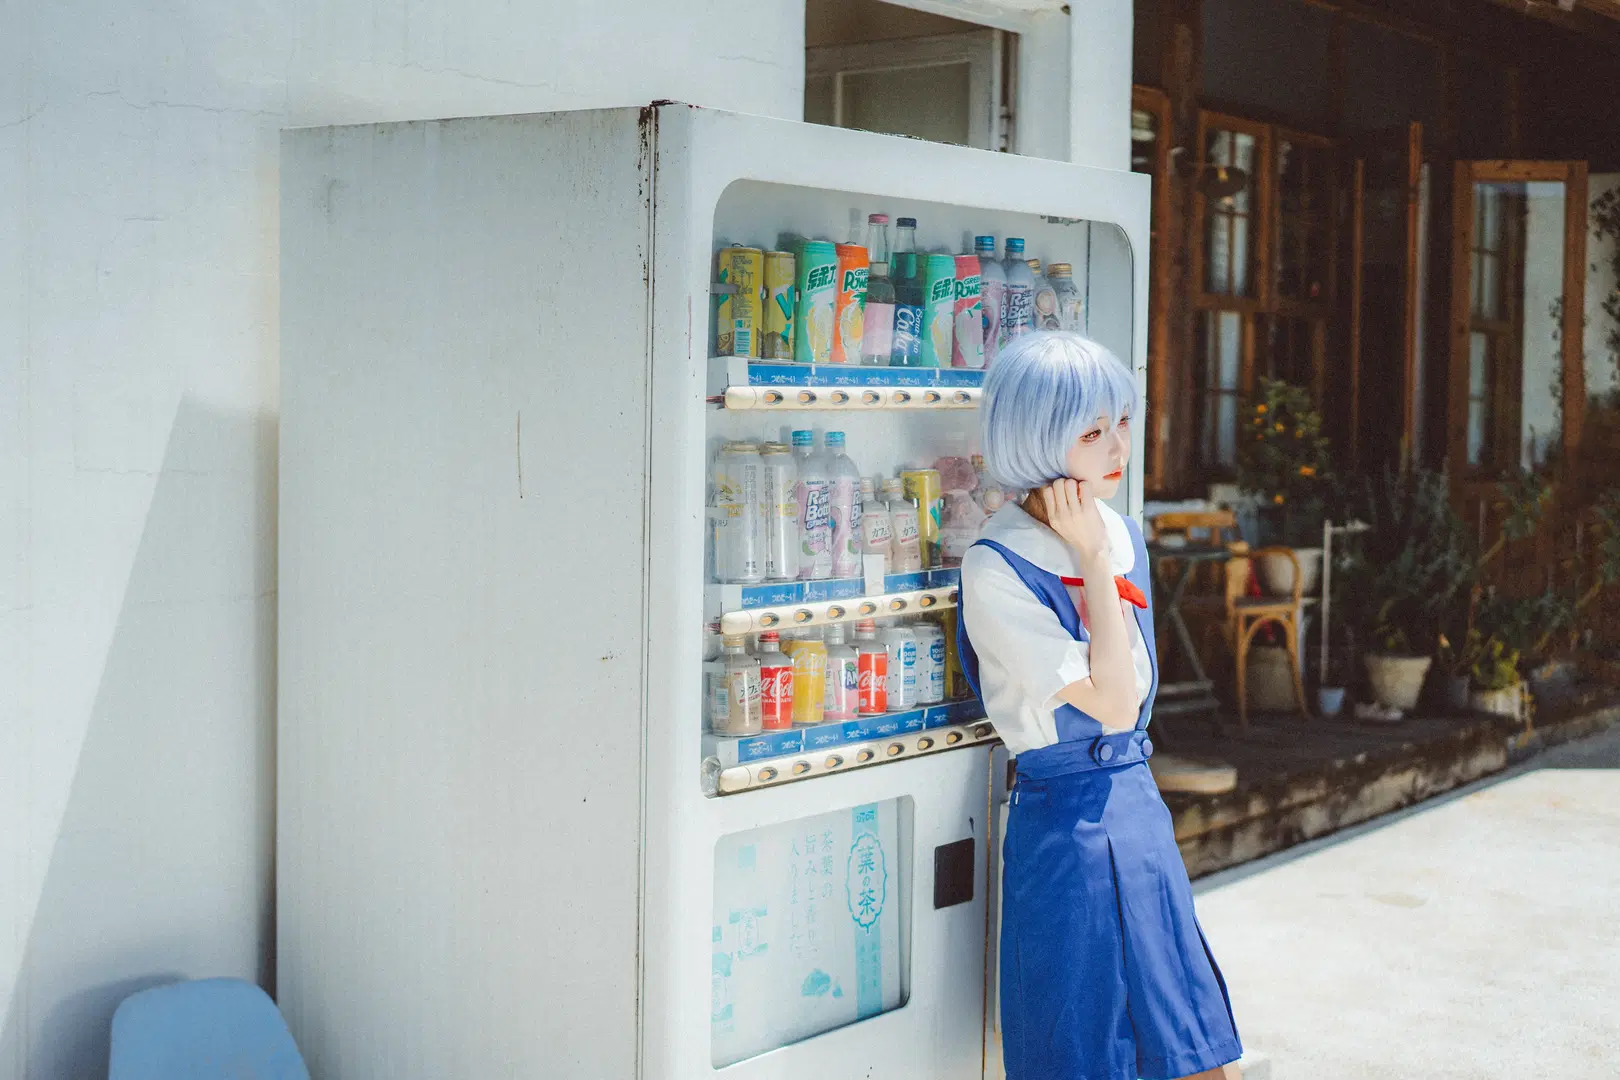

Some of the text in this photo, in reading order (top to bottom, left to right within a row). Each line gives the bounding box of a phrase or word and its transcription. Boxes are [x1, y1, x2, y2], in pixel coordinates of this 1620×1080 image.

[843, 270, 868, 292] POWE
[954, 281, 981, 301] POWE
[857, 844, 876, 916] 葉の茶
